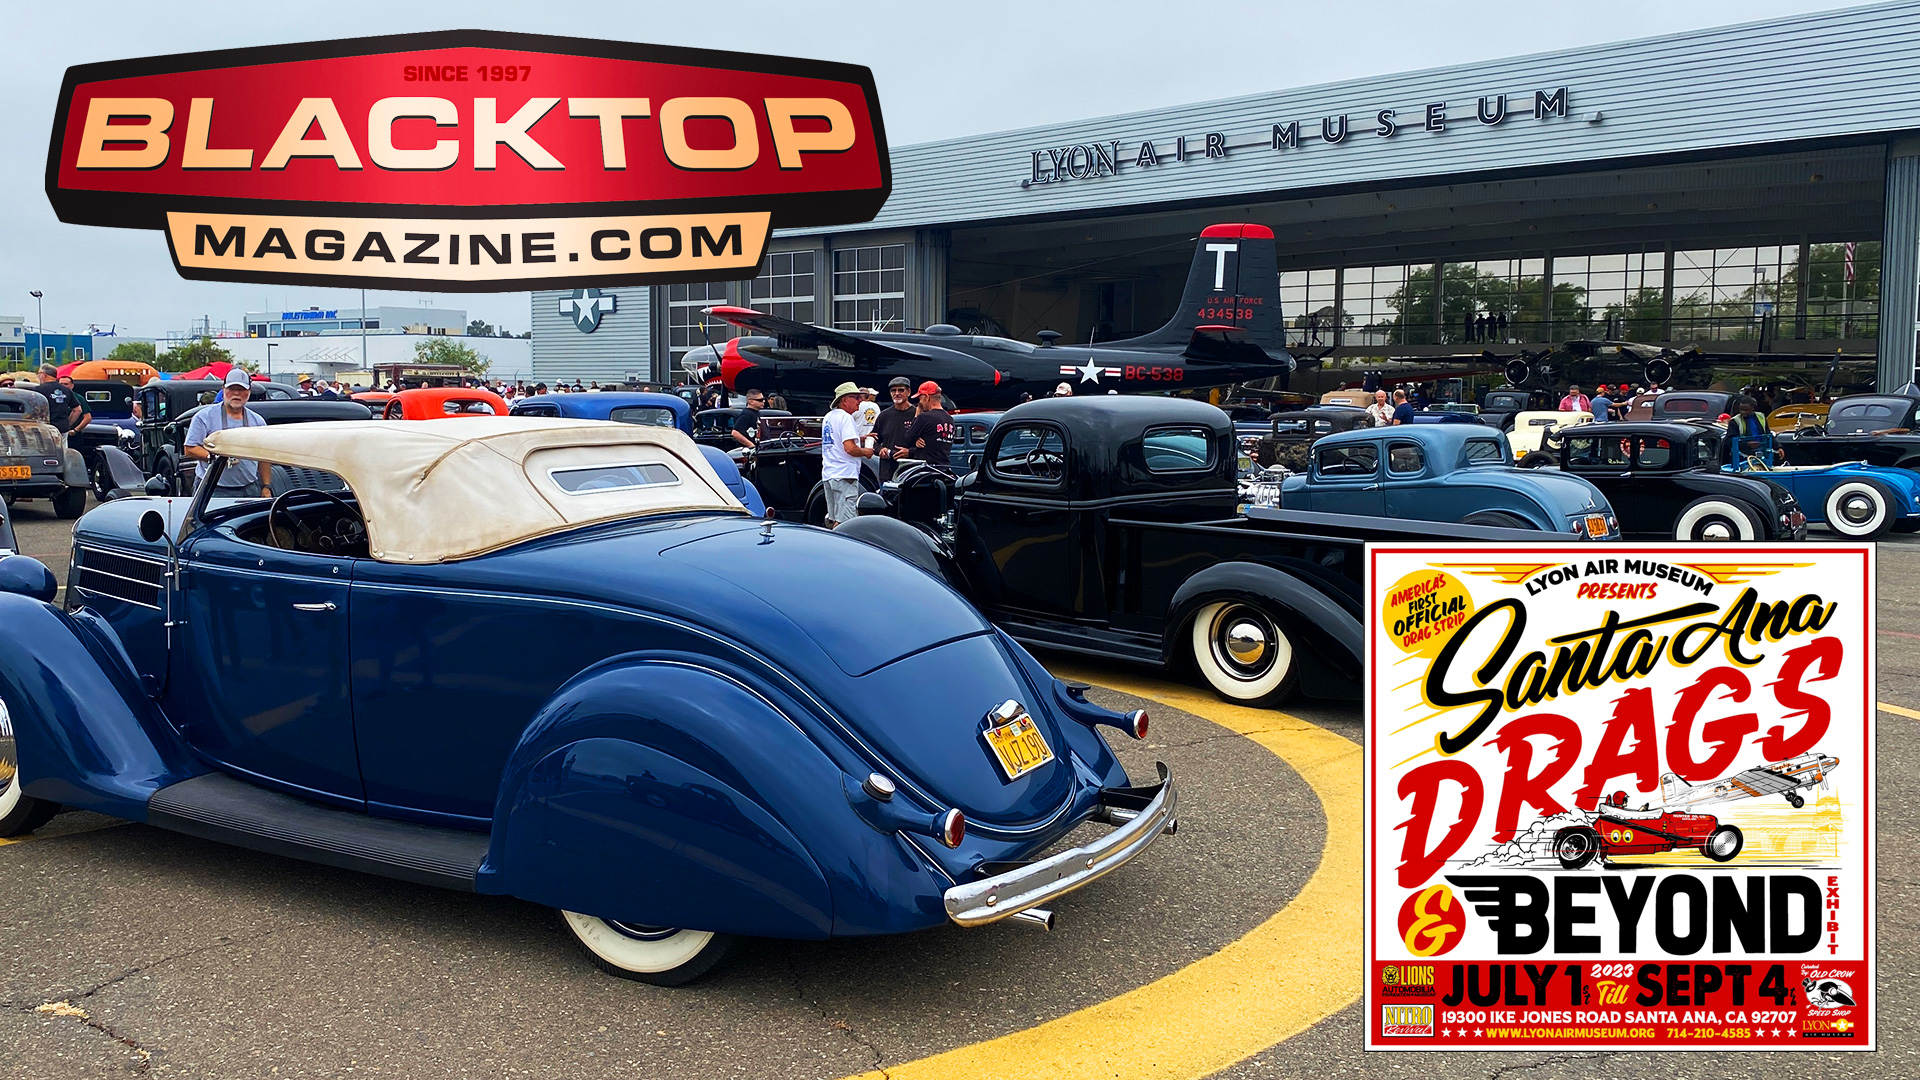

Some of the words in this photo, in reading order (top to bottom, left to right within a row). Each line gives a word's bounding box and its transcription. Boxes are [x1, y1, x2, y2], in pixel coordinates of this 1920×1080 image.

[1029, 140, 1120, 184] LYON
[1135, 131, 1225, 167] AIR
[1271, 85, 1569, 151] MUSEUM
[1205, 243, 1238, 291] T
[1239, 297, 1263, 305] FORCE
[1197, 308, 1253, 320] 434538
[1125, 365, 1184, 382] BC-538
[1021, 731, 1047, 761] 190
